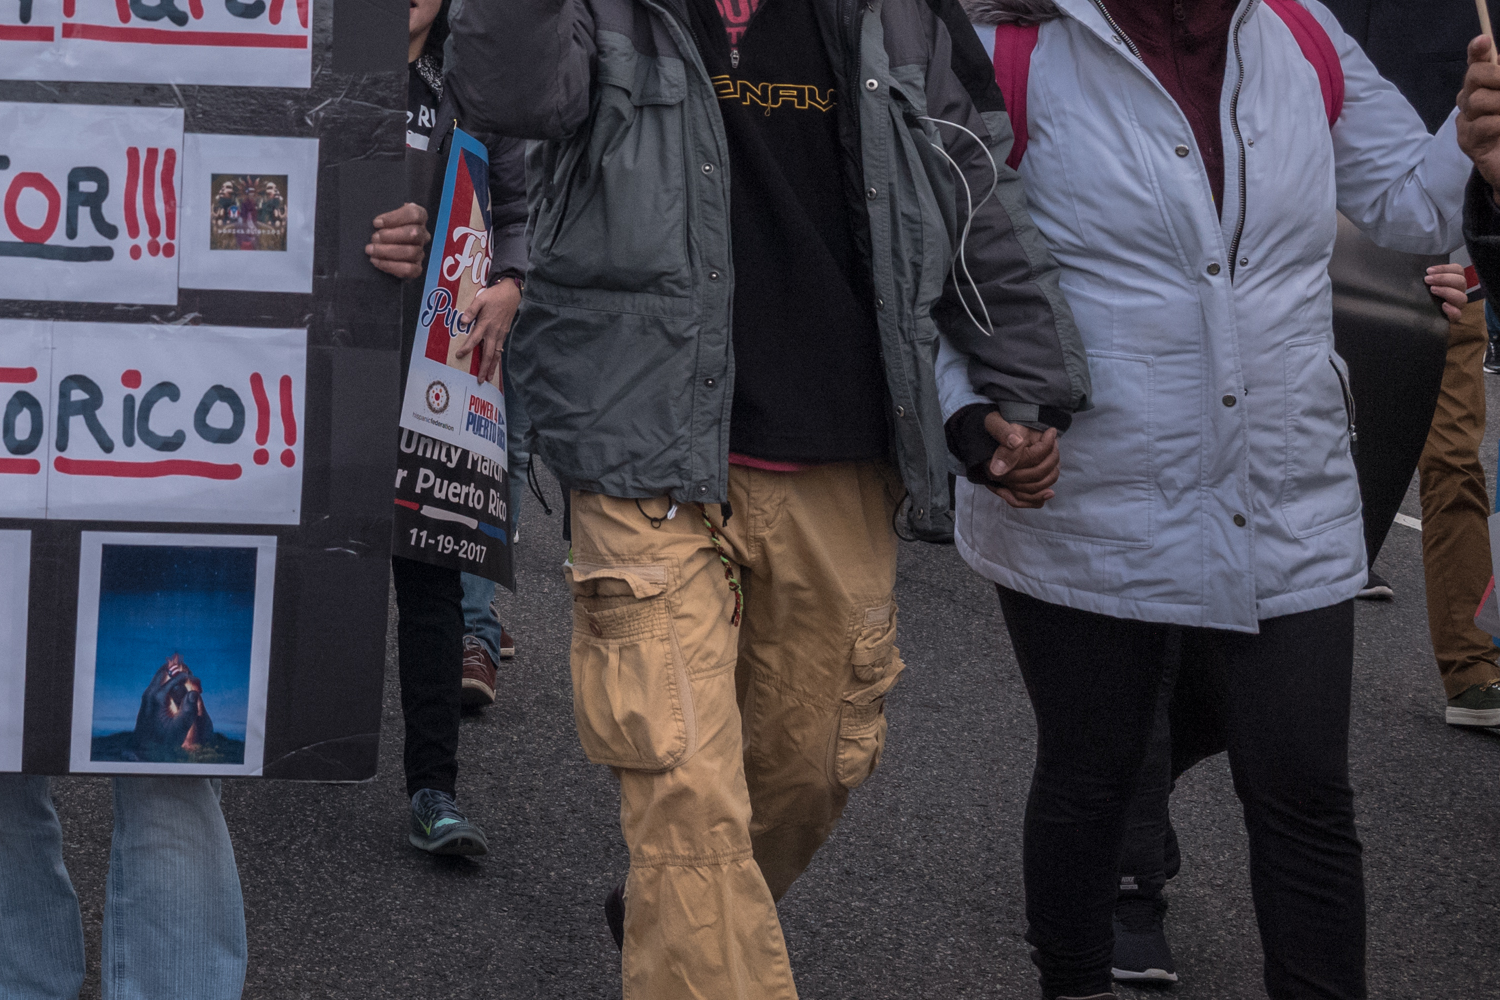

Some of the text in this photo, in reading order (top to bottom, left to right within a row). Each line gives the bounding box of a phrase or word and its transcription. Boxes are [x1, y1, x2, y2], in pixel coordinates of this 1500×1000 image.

[468, 394, 494, 421] POWER
[466, 411, 497, 444] PUERTO
[415, 467, 484, 510] Puerto
[488, 488, 507, 521] Rico
[410, 528, 487, 563] 11-19-2017
